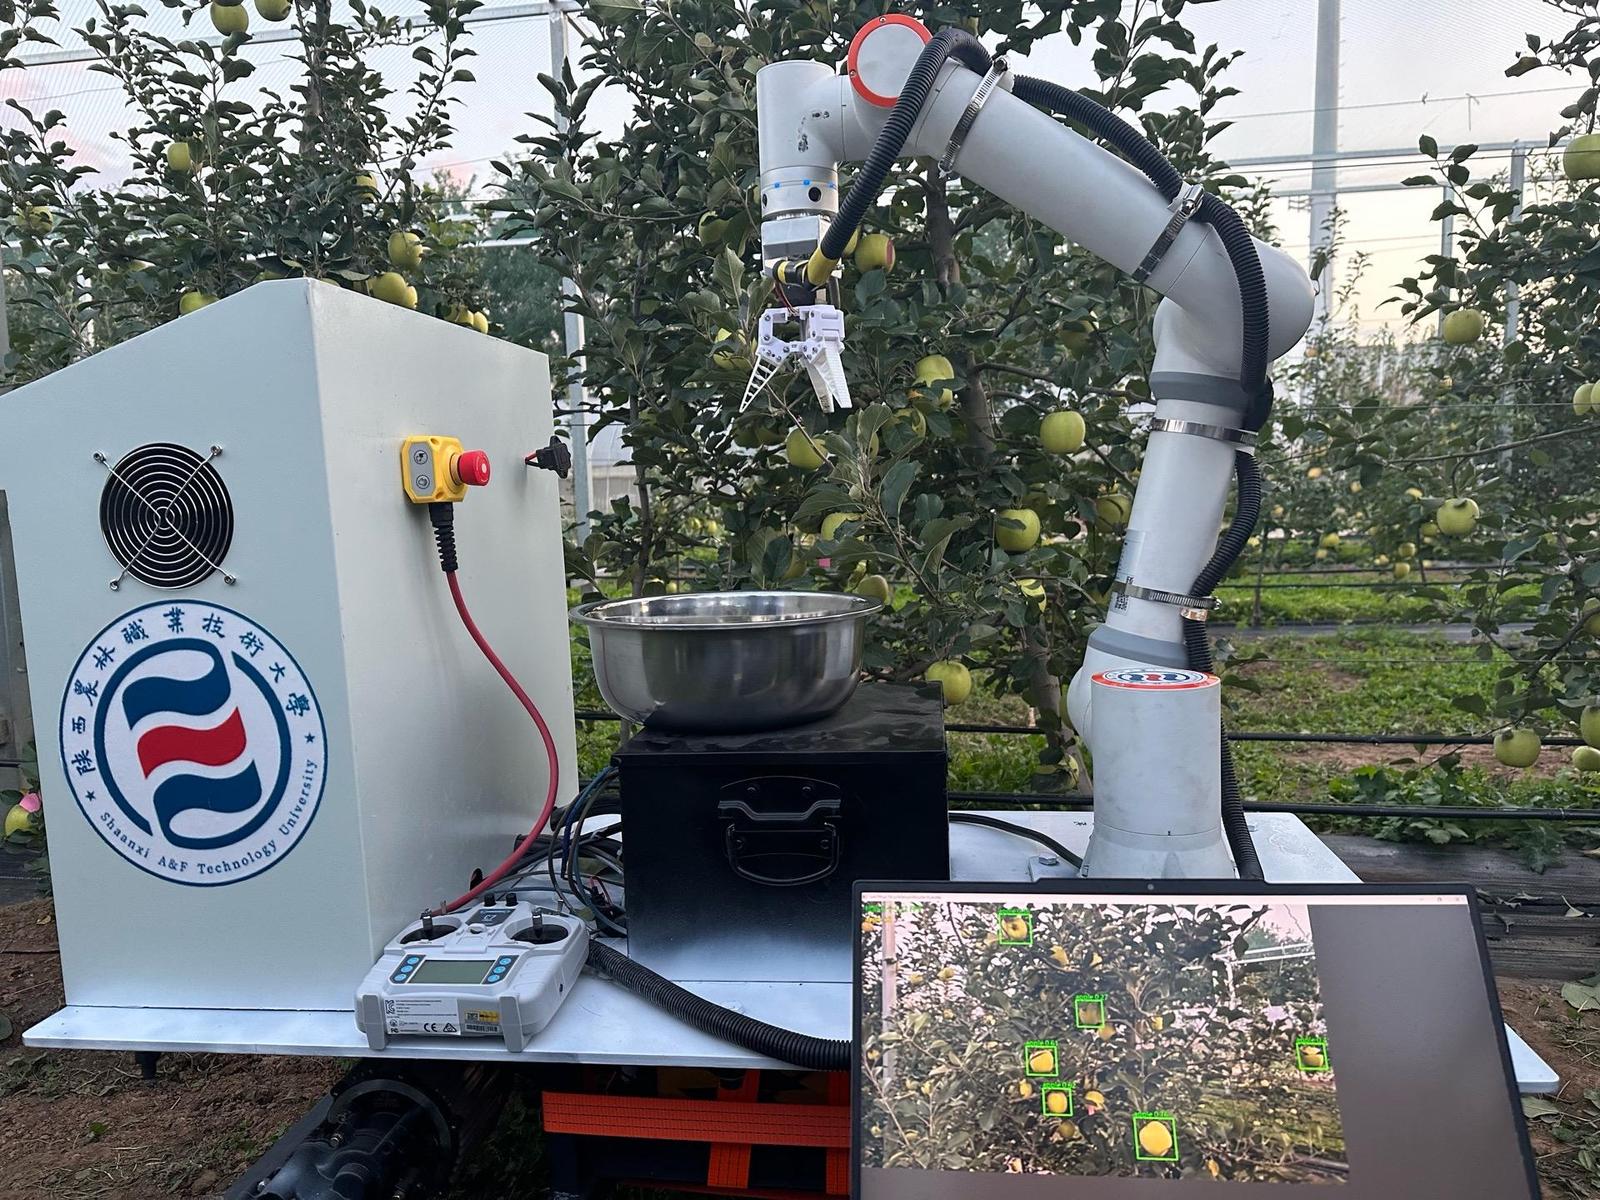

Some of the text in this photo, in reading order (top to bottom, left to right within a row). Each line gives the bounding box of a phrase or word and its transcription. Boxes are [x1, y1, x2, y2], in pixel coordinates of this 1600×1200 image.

[100, 759, 318, 875] Shaanxi A&F Technology University
[424, 1023, 438, 1033] CE
